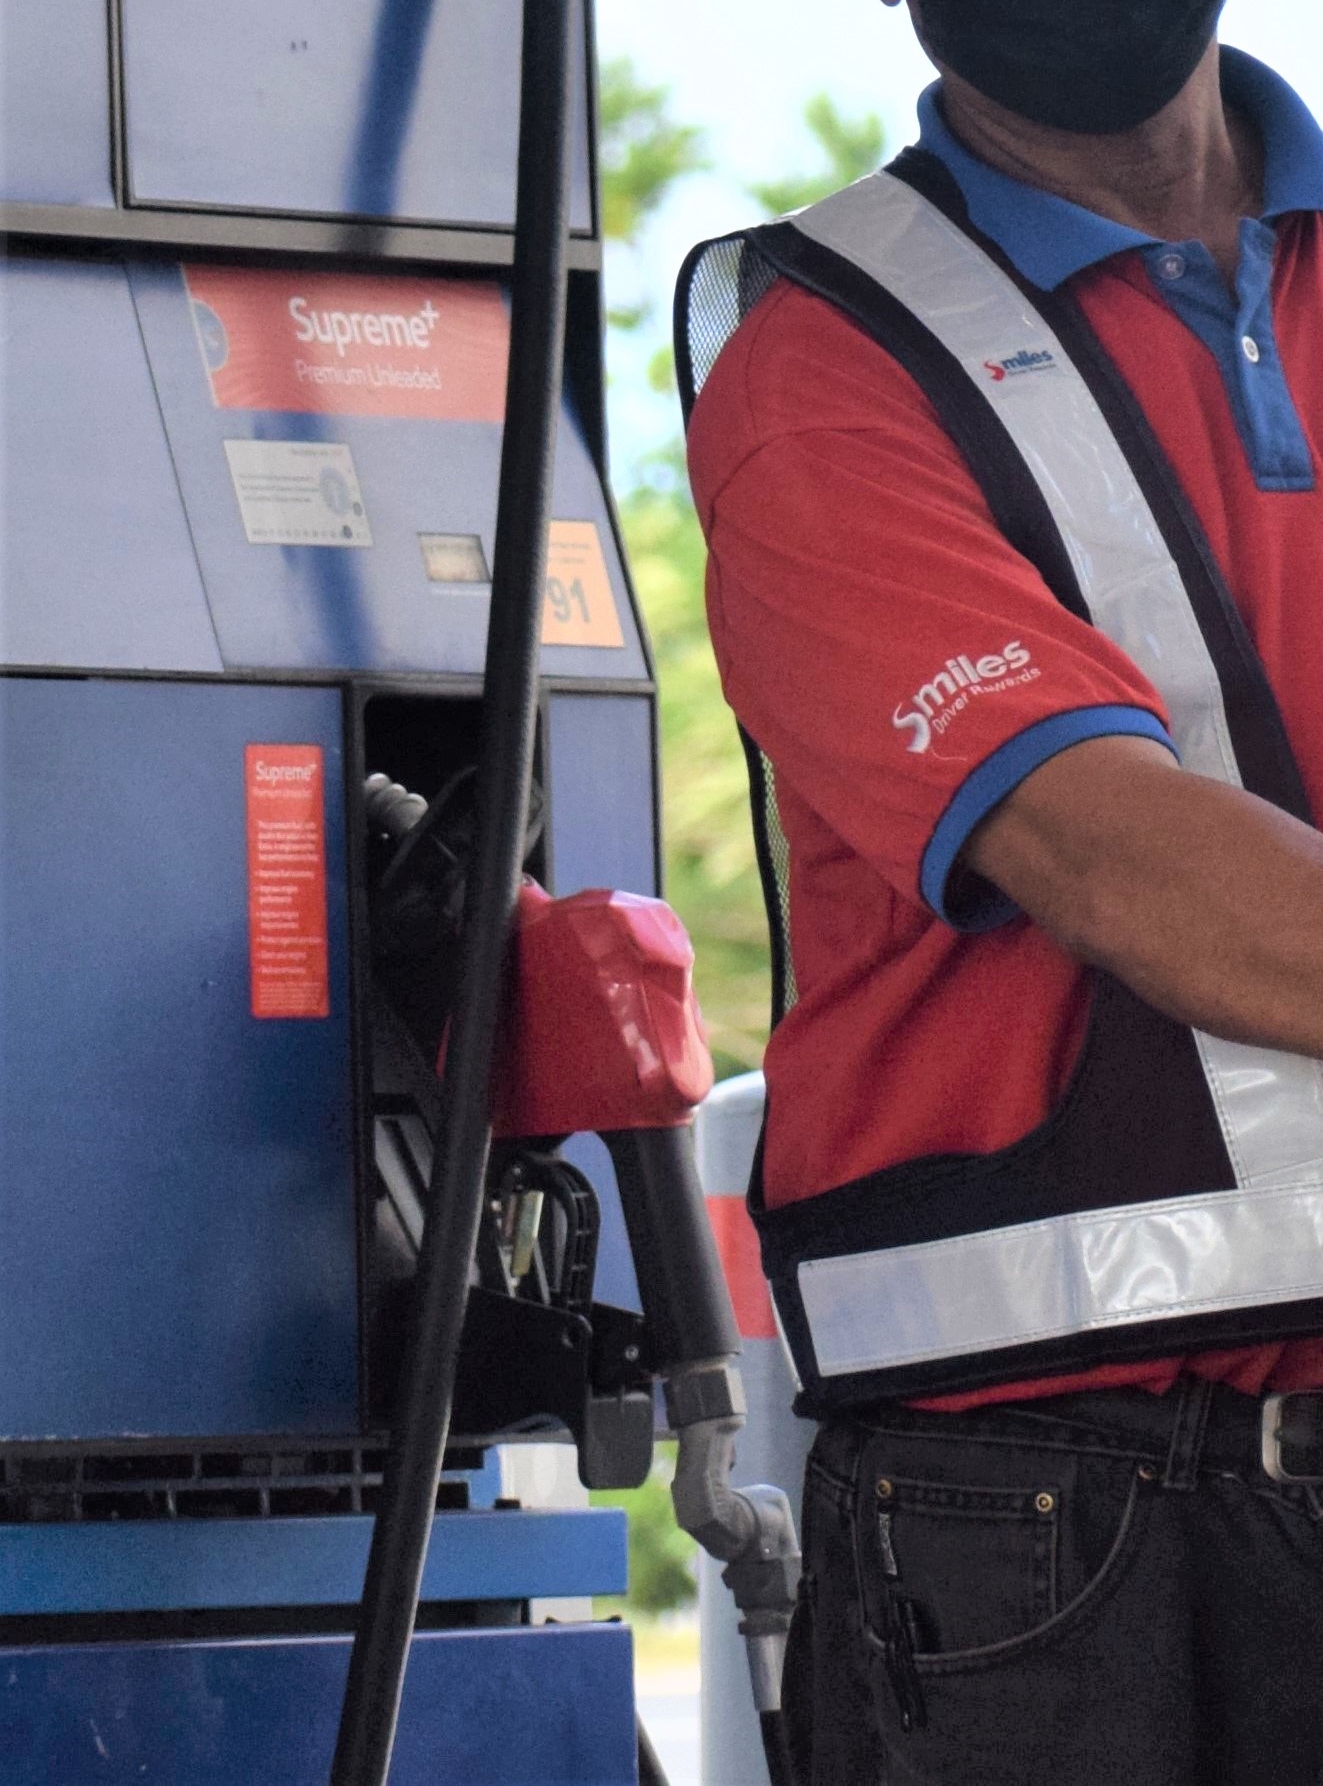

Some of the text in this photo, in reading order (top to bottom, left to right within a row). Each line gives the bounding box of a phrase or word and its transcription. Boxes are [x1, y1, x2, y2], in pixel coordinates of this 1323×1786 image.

[288, 296, 439, 358] Supreme+
[295, 359, 442, 391] Premium Unleaded
[546, 576, 591, 624] 91
[892, 640, 1031, 754] Smiles
[931, 691, 970, 735] Driver
